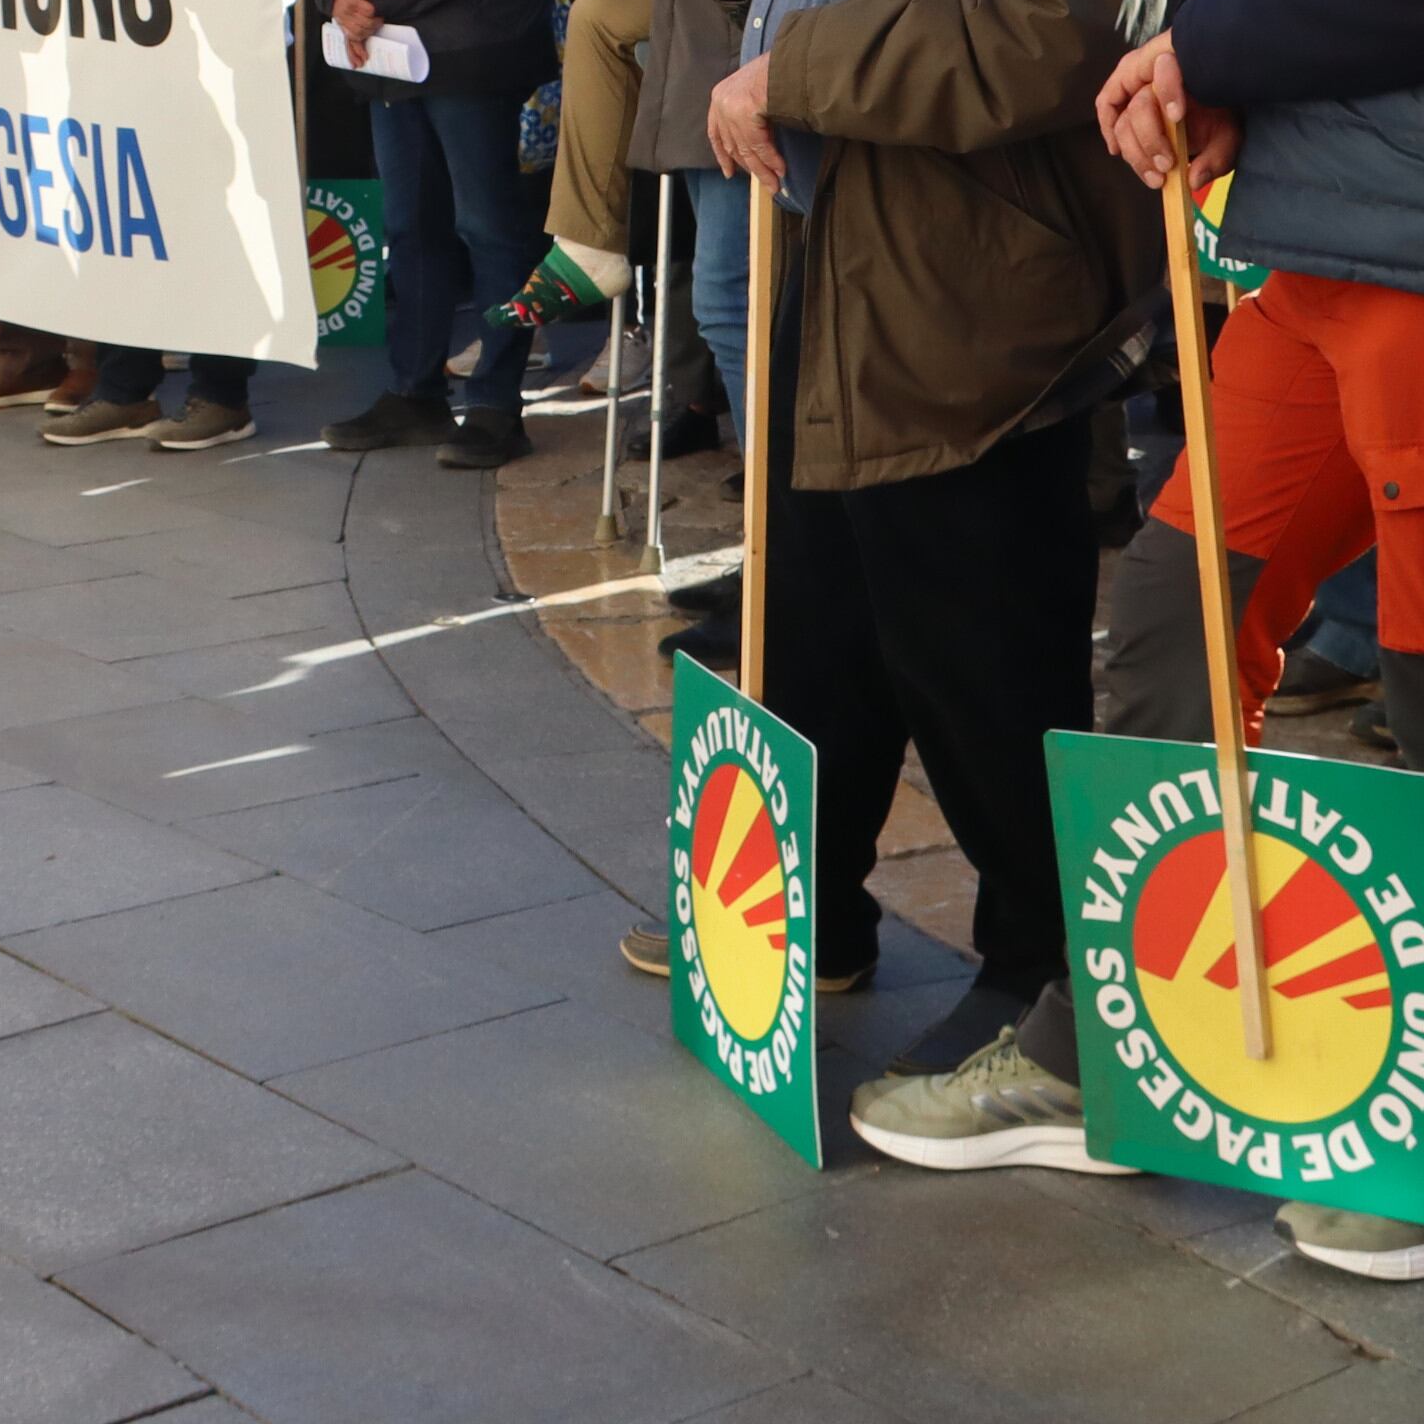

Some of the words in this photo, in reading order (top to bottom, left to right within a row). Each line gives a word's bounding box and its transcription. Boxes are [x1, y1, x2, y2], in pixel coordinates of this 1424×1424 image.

[350, 218, 376, 252] DE
[343, 260, 377, 319] UNIÓ
[674, 706, 790, 829] CATALUNYA
[782, 831, 807, 919] DE
[1081, 768, 1375, 924] CATLUNYA
[673, 847, 746, 1085] PAGESOS
[773, 942, 807, 1084] UNIÓ
[748, 1043, 778, 1096] DE
[1085, 946, 1284, 1180] PAGESOS
[1292, 1121, 1376, 1183] DE
